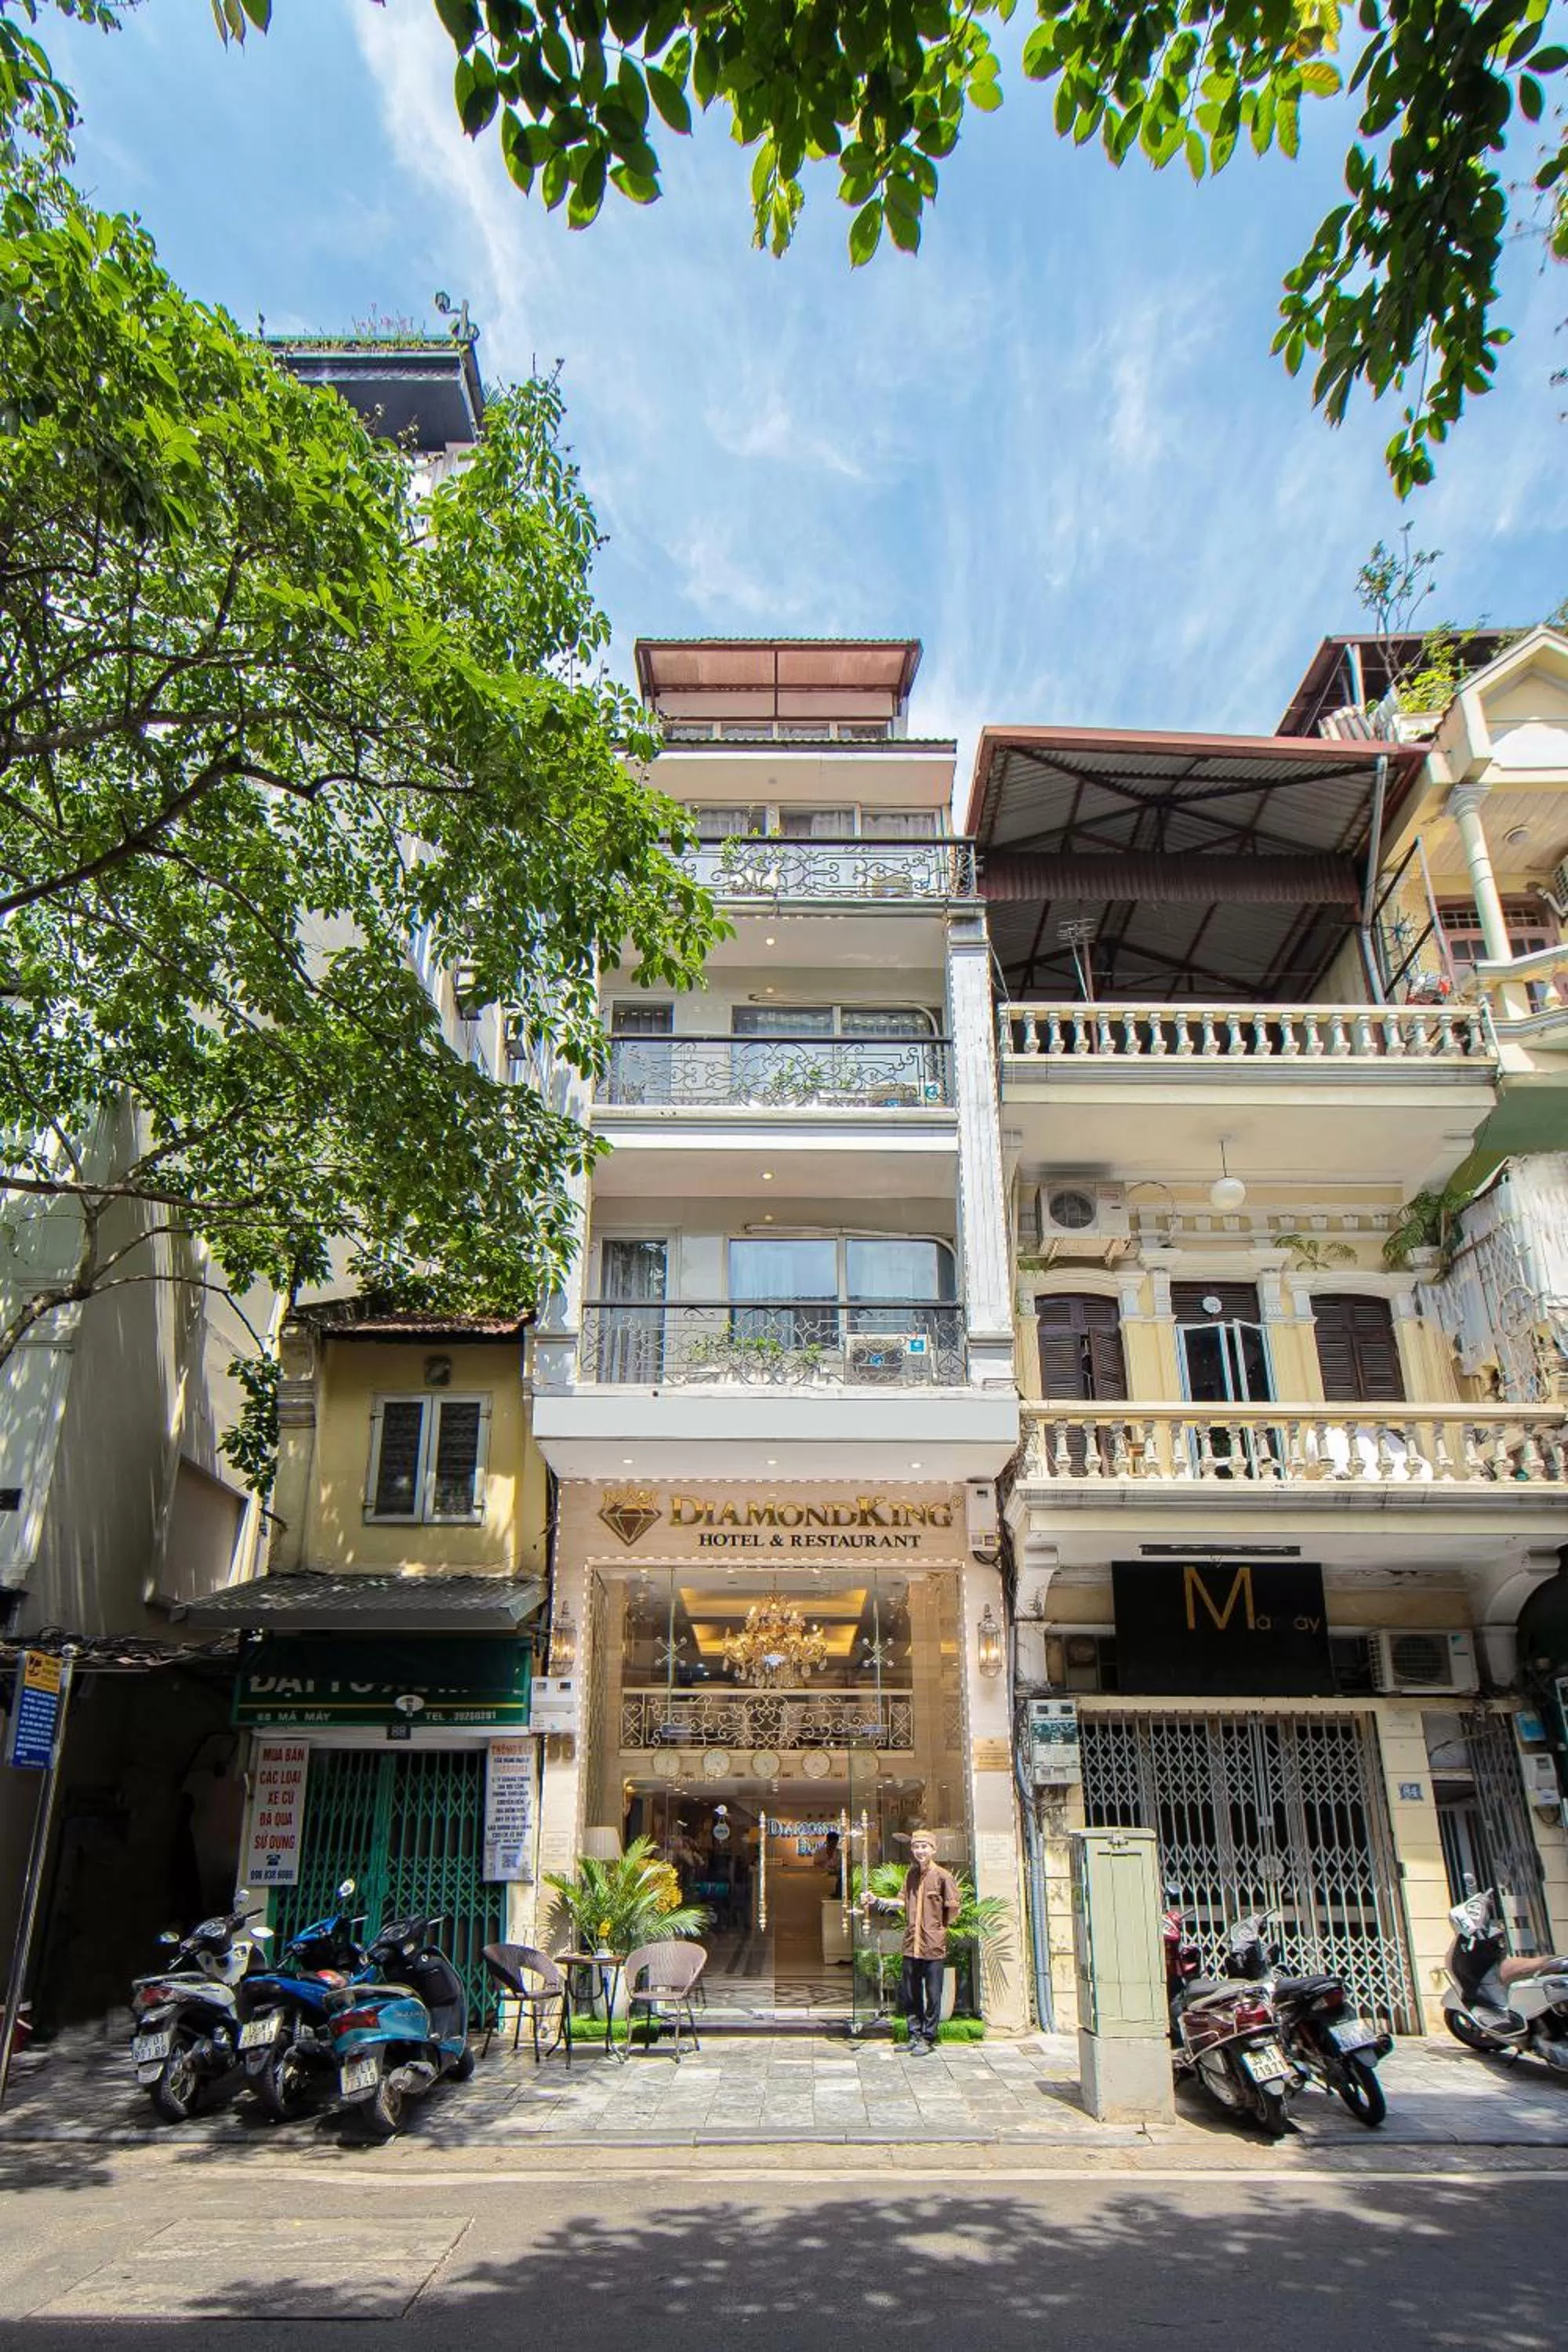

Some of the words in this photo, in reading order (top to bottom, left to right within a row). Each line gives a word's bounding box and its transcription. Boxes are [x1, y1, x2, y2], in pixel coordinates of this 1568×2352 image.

[699, 1533, 764, 1547] HOTEL
[770, 1534, 783, 1547] &
[790, 1534, 921, 1548] RESTAURANT
[263, 1748, 282, 1762] MUA
[285, 1745, 305, 1762] BÁN
[260, 1766, 280, 1784] CÁC
[281, 1769, 302, 1787] LOẠI
[268, 1791, 279, 1805] XE
[274, 1811, 292, 1827] QUA
